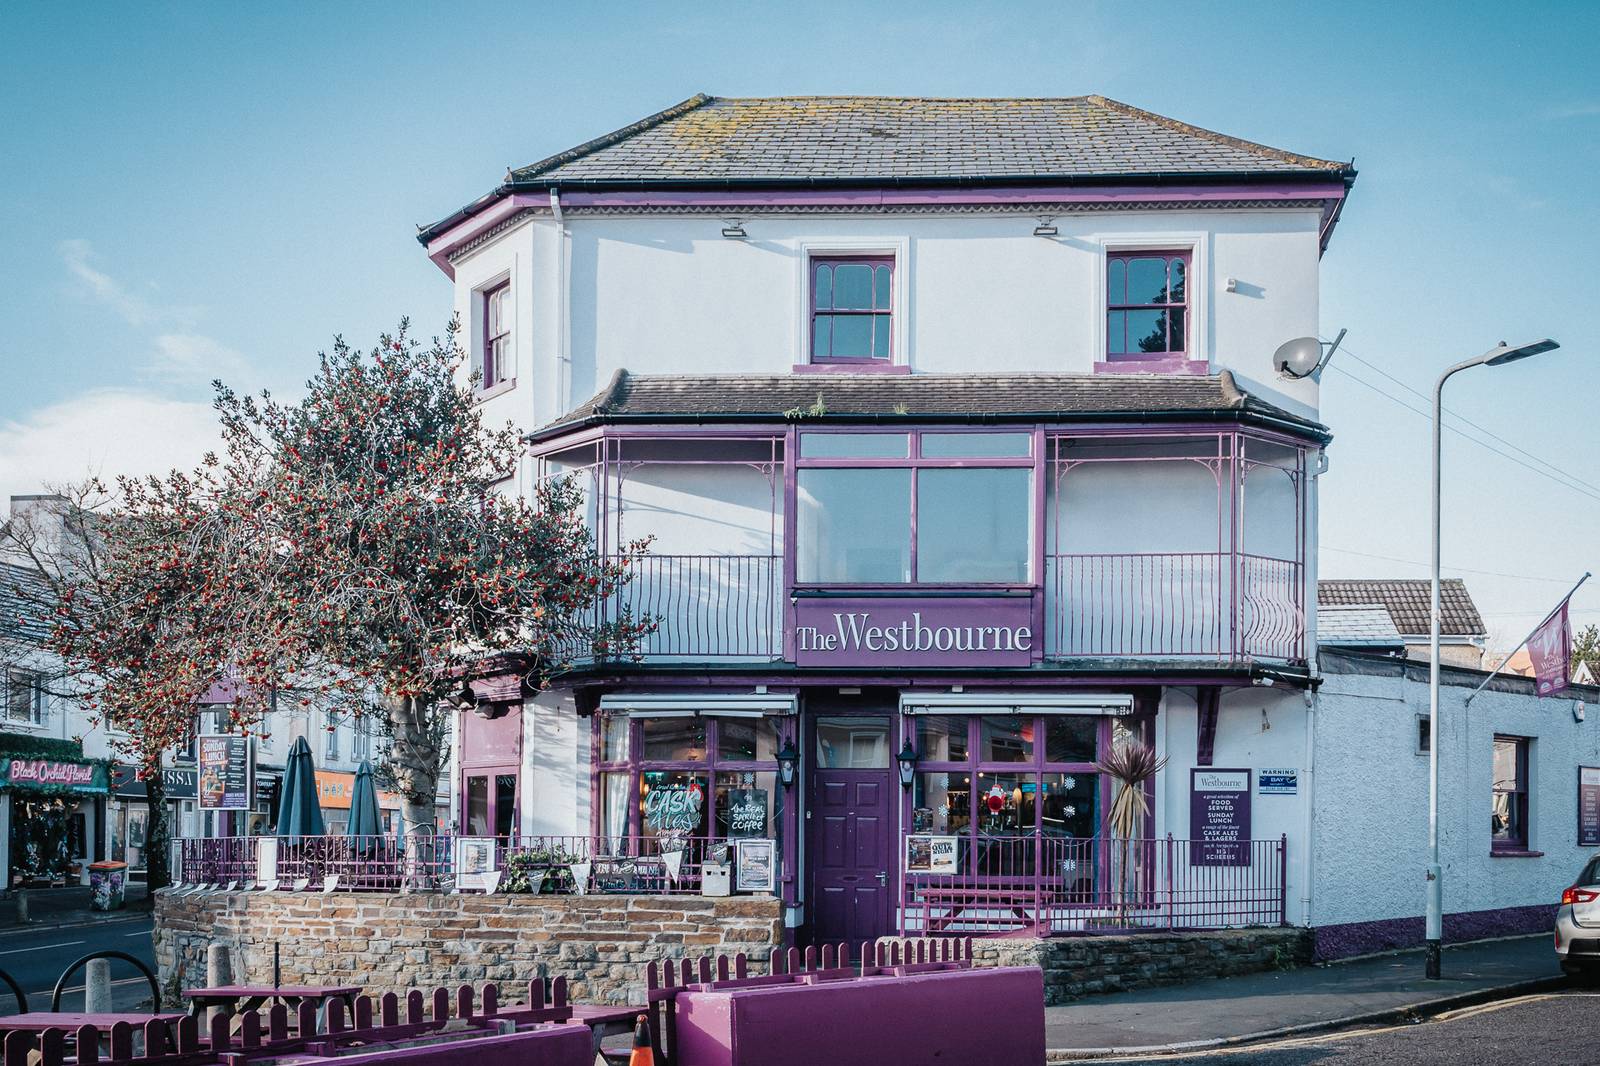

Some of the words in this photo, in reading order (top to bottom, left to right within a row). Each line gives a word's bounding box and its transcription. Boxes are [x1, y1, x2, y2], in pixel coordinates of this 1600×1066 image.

[796, 627, 838, 651] The
[833, 612, 1032, 652] Westbourne
[203, 742, 226, 752] SUNDAY
[205, 751, 225, 761] LUNCH
[11, 760, 38, 779] Black
[38, 763, 66, 782] Orchid
[66, 763, 93, 781] Florist
[1201, 777, 1241, 787] Westbourne
[646, 789, 702, 814] CASK
[649, 811, 693, 832] Ales
